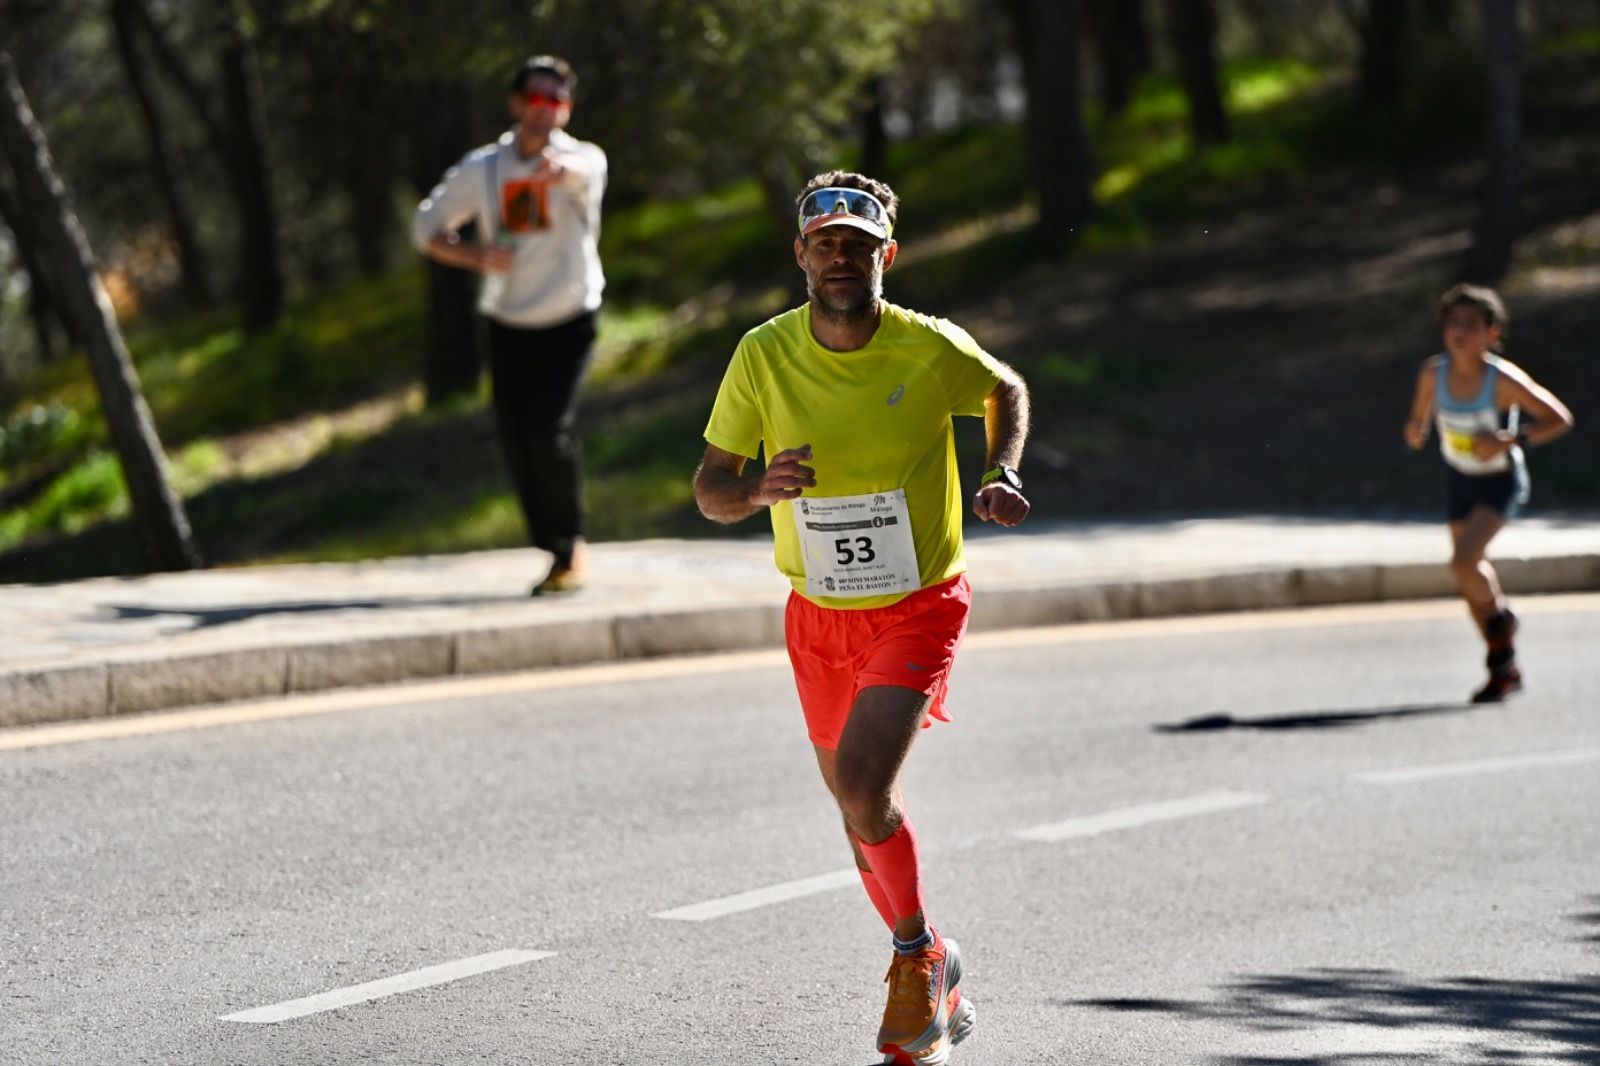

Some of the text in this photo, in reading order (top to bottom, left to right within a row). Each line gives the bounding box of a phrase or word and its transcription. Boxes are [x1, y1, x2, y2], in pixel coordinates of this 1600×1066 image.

[835, 536, 876, 565] 53
[863, 574, 896, 582] MARATÓN
[866, 581, 891, 590] BASTÓN
